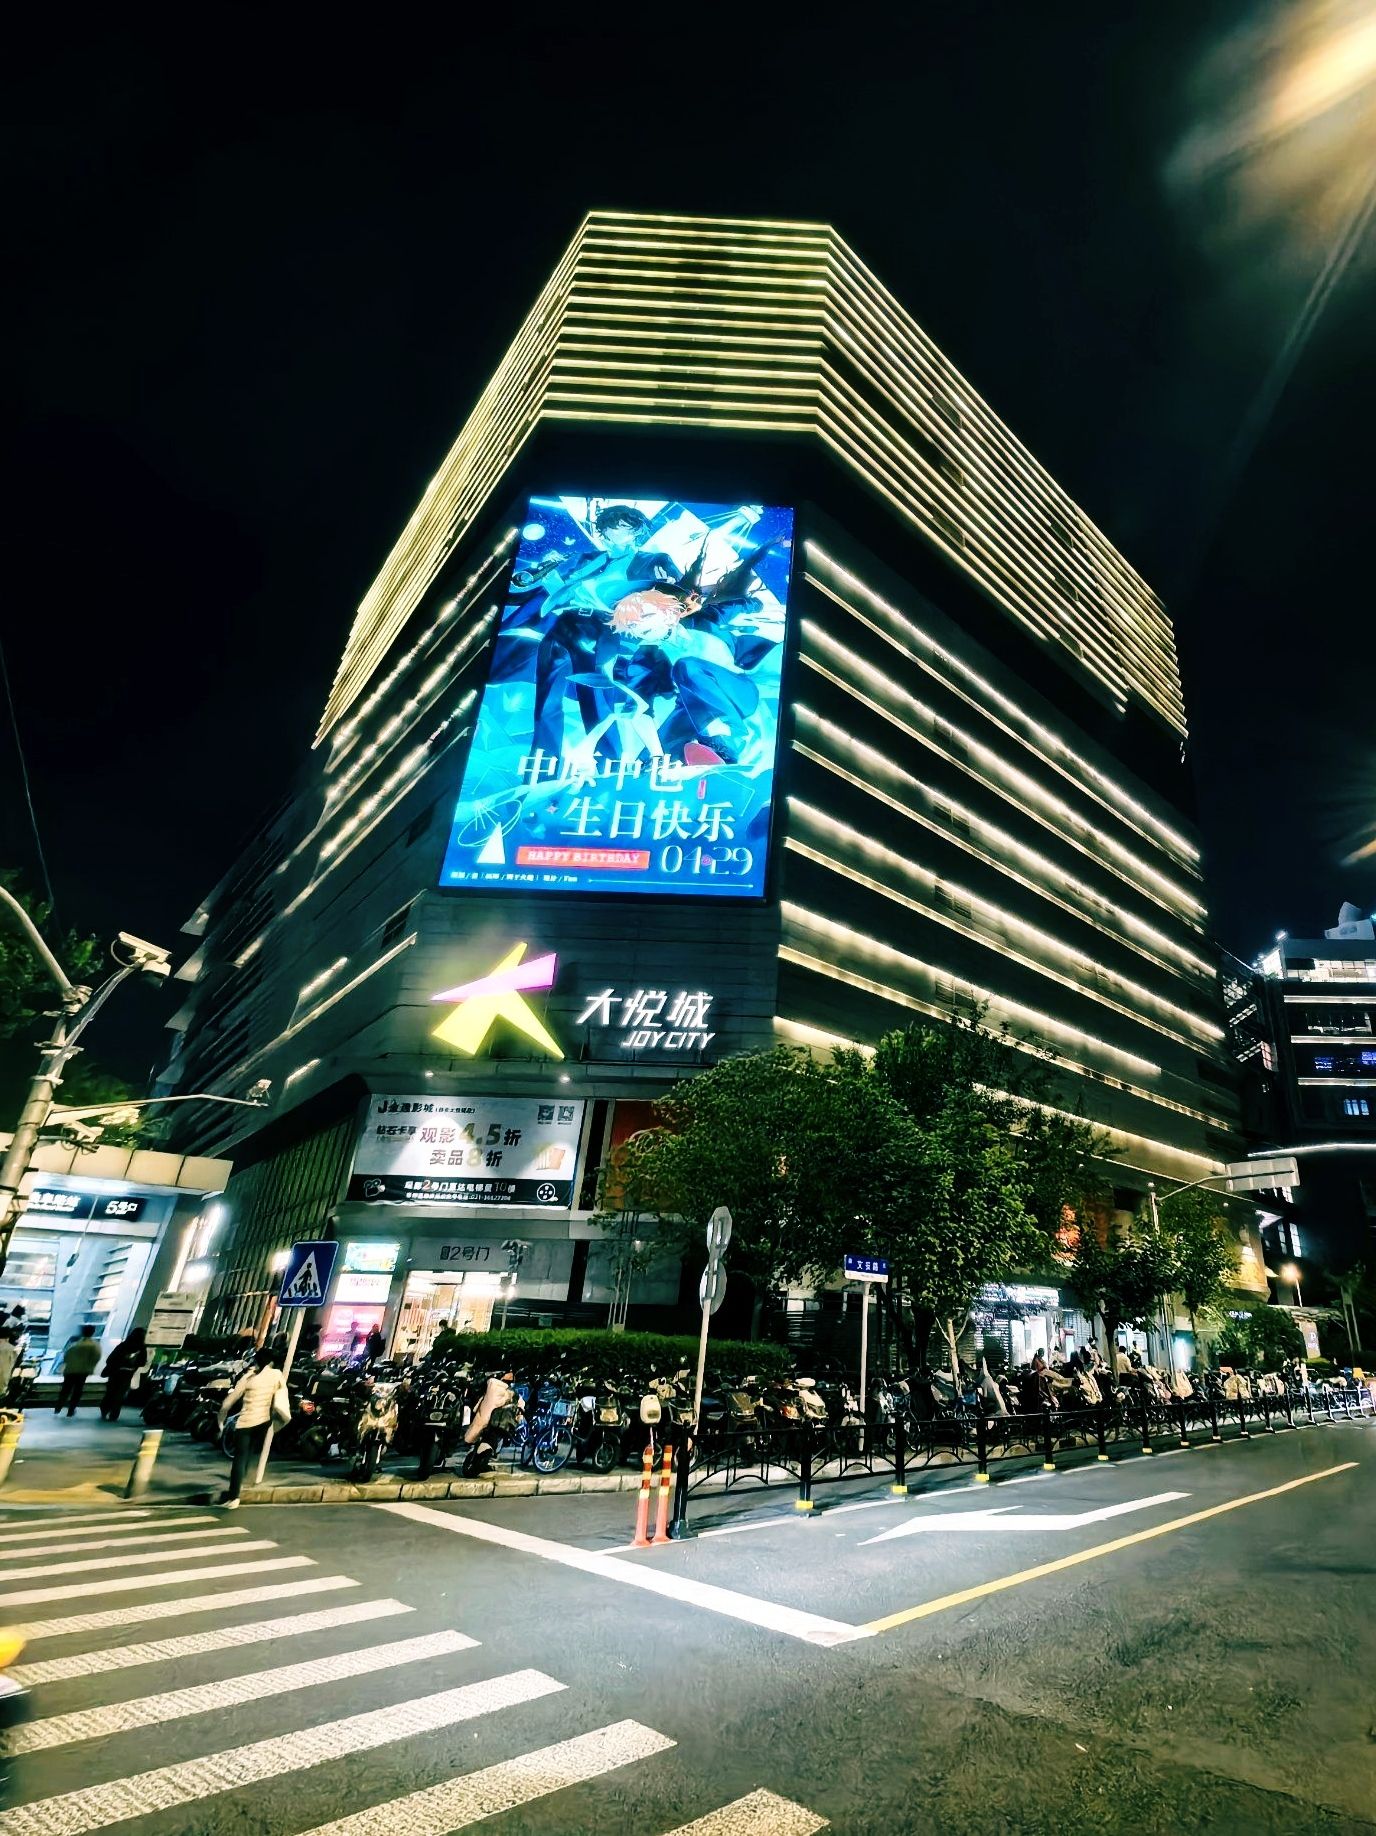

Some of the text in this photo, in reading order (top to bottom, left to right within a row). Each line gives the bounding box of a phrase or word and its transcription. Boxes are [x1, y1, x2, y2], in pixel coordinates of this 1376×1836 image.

[517, 748, 684, 793] 中原中也
[559, 798, 736, 842] 生日快乐
[527, 851, 640, 864] HAPPY BIRTHDAY
[576, 988, 714, 1028] 大悦城
[622, 1030, 716, 1049] JOY CITY
